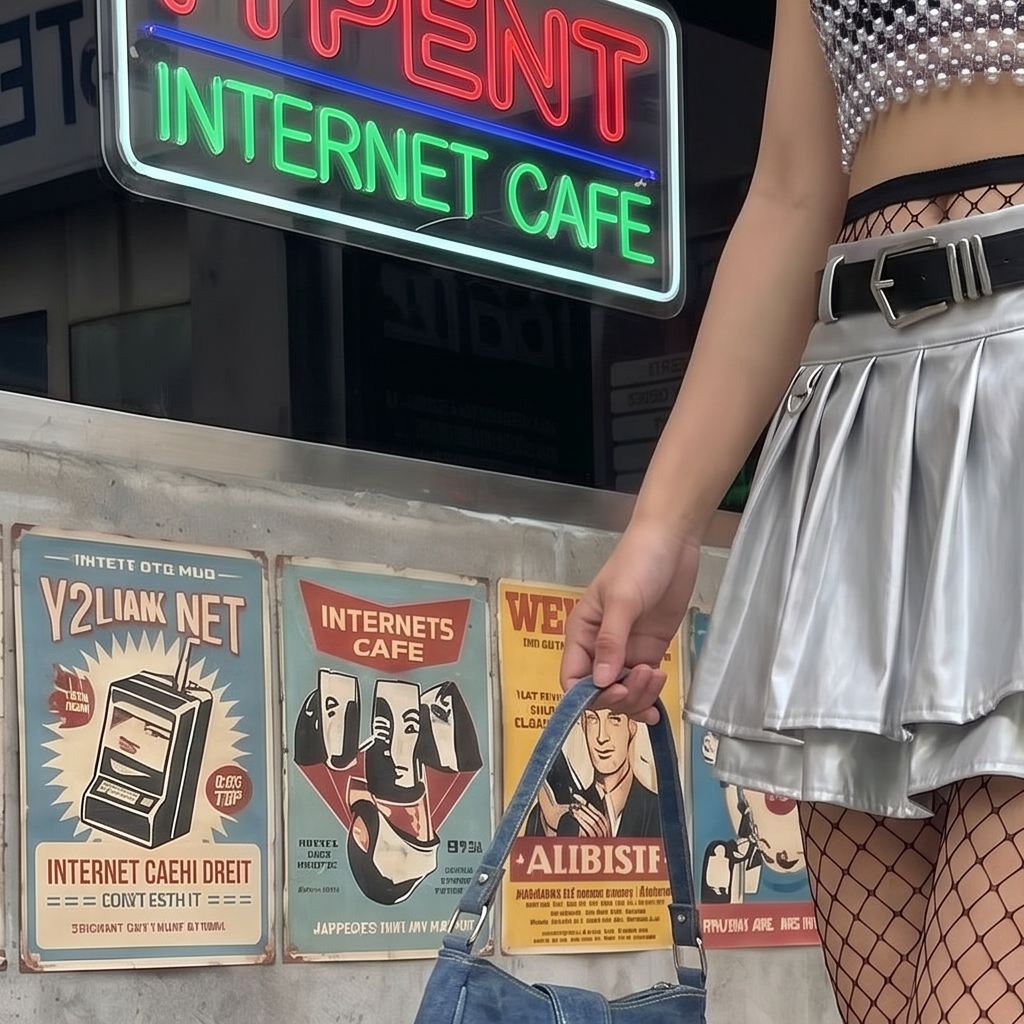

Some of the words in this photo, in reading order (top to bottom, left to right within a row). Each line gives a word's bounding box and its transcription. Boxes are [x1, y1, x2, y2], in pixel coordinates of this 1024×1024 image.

[157, 62, 489, 219] INTERNET
[508, 163, 656, 264] CAFE
[175, 592, 245, 655] NET
[321, 604, 454, 641] INTERNETS
[353, 638, 424, 662] CAFE
[47, 859, 140, 885] INTERNET
[145, 859, 197, 884] CAEHI
[202, 859, 252, 884] DREIT
